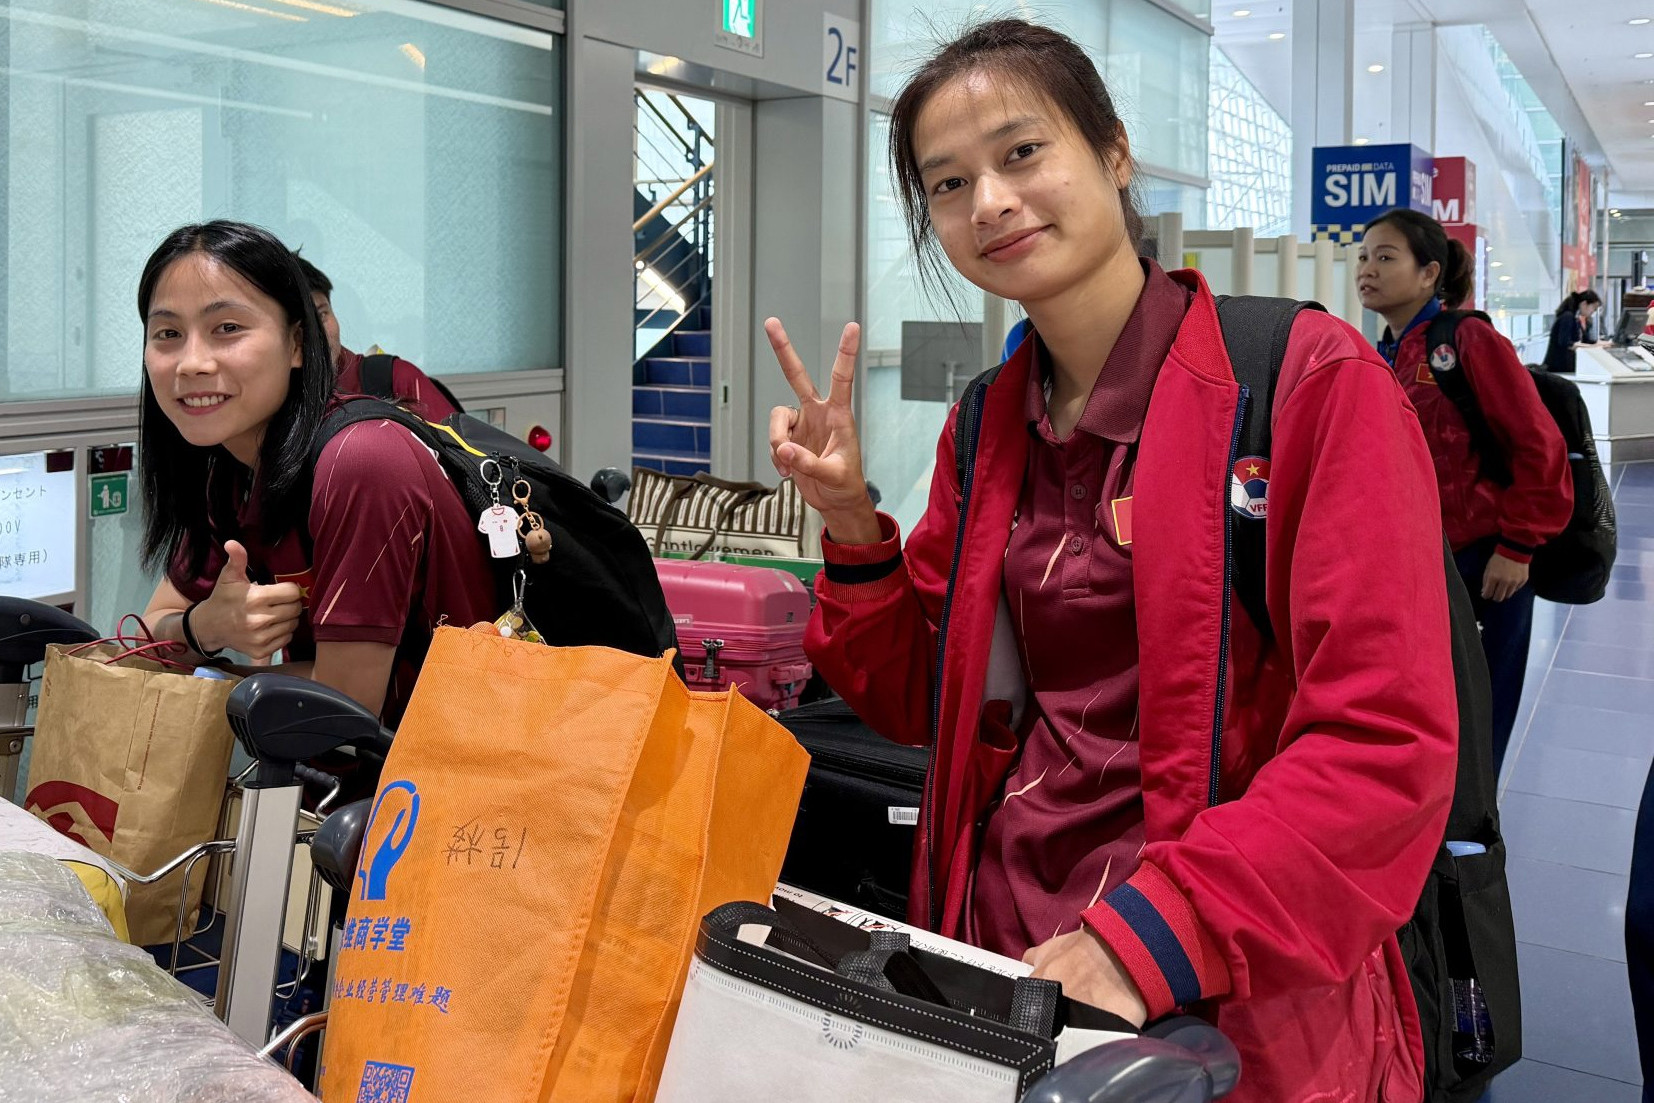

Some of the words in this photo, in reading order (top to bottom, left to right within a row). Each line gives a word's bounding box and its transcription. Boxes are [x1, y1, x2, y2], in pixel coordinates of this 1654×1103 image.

[827, 26, 857, 86] 2F
[1326, 163, 1361, 173] PREPAID
[1373, 161, 1395, 171] DATA
[1324, 172, 1396, 207] SIM
